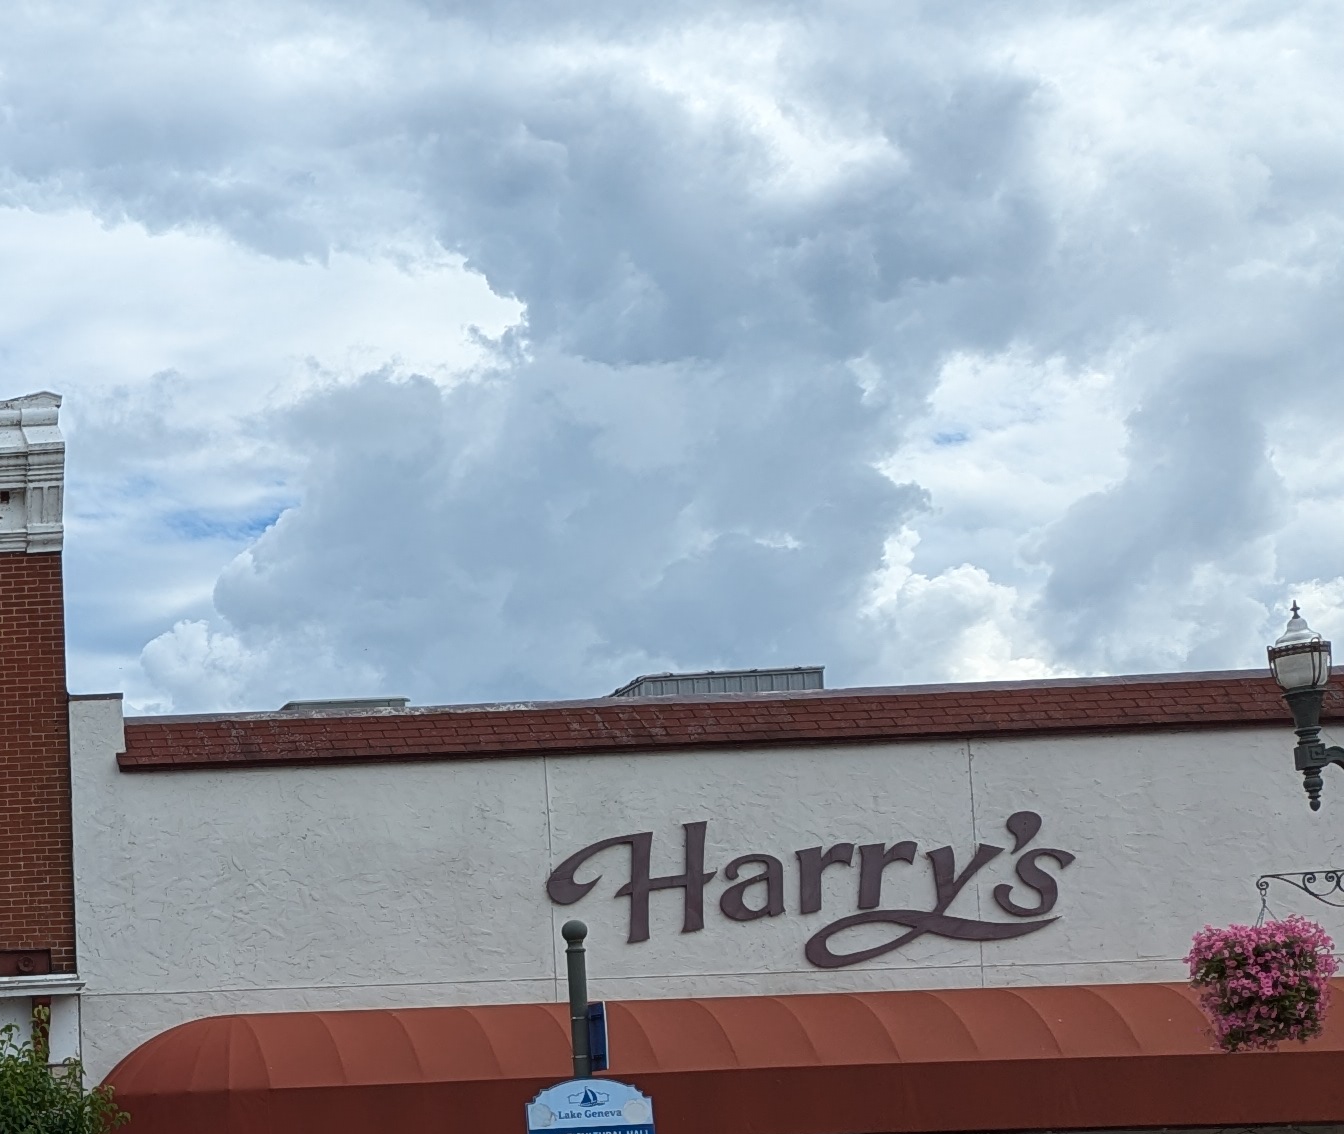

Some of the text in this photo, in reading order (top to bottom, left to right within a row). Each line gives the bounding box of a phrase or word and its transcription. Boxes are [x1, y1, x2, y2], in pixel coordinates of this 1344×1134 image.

[546, 810, 1076, 968] Harry's
[558, 1109, 623, 1120] Lake Geneva
